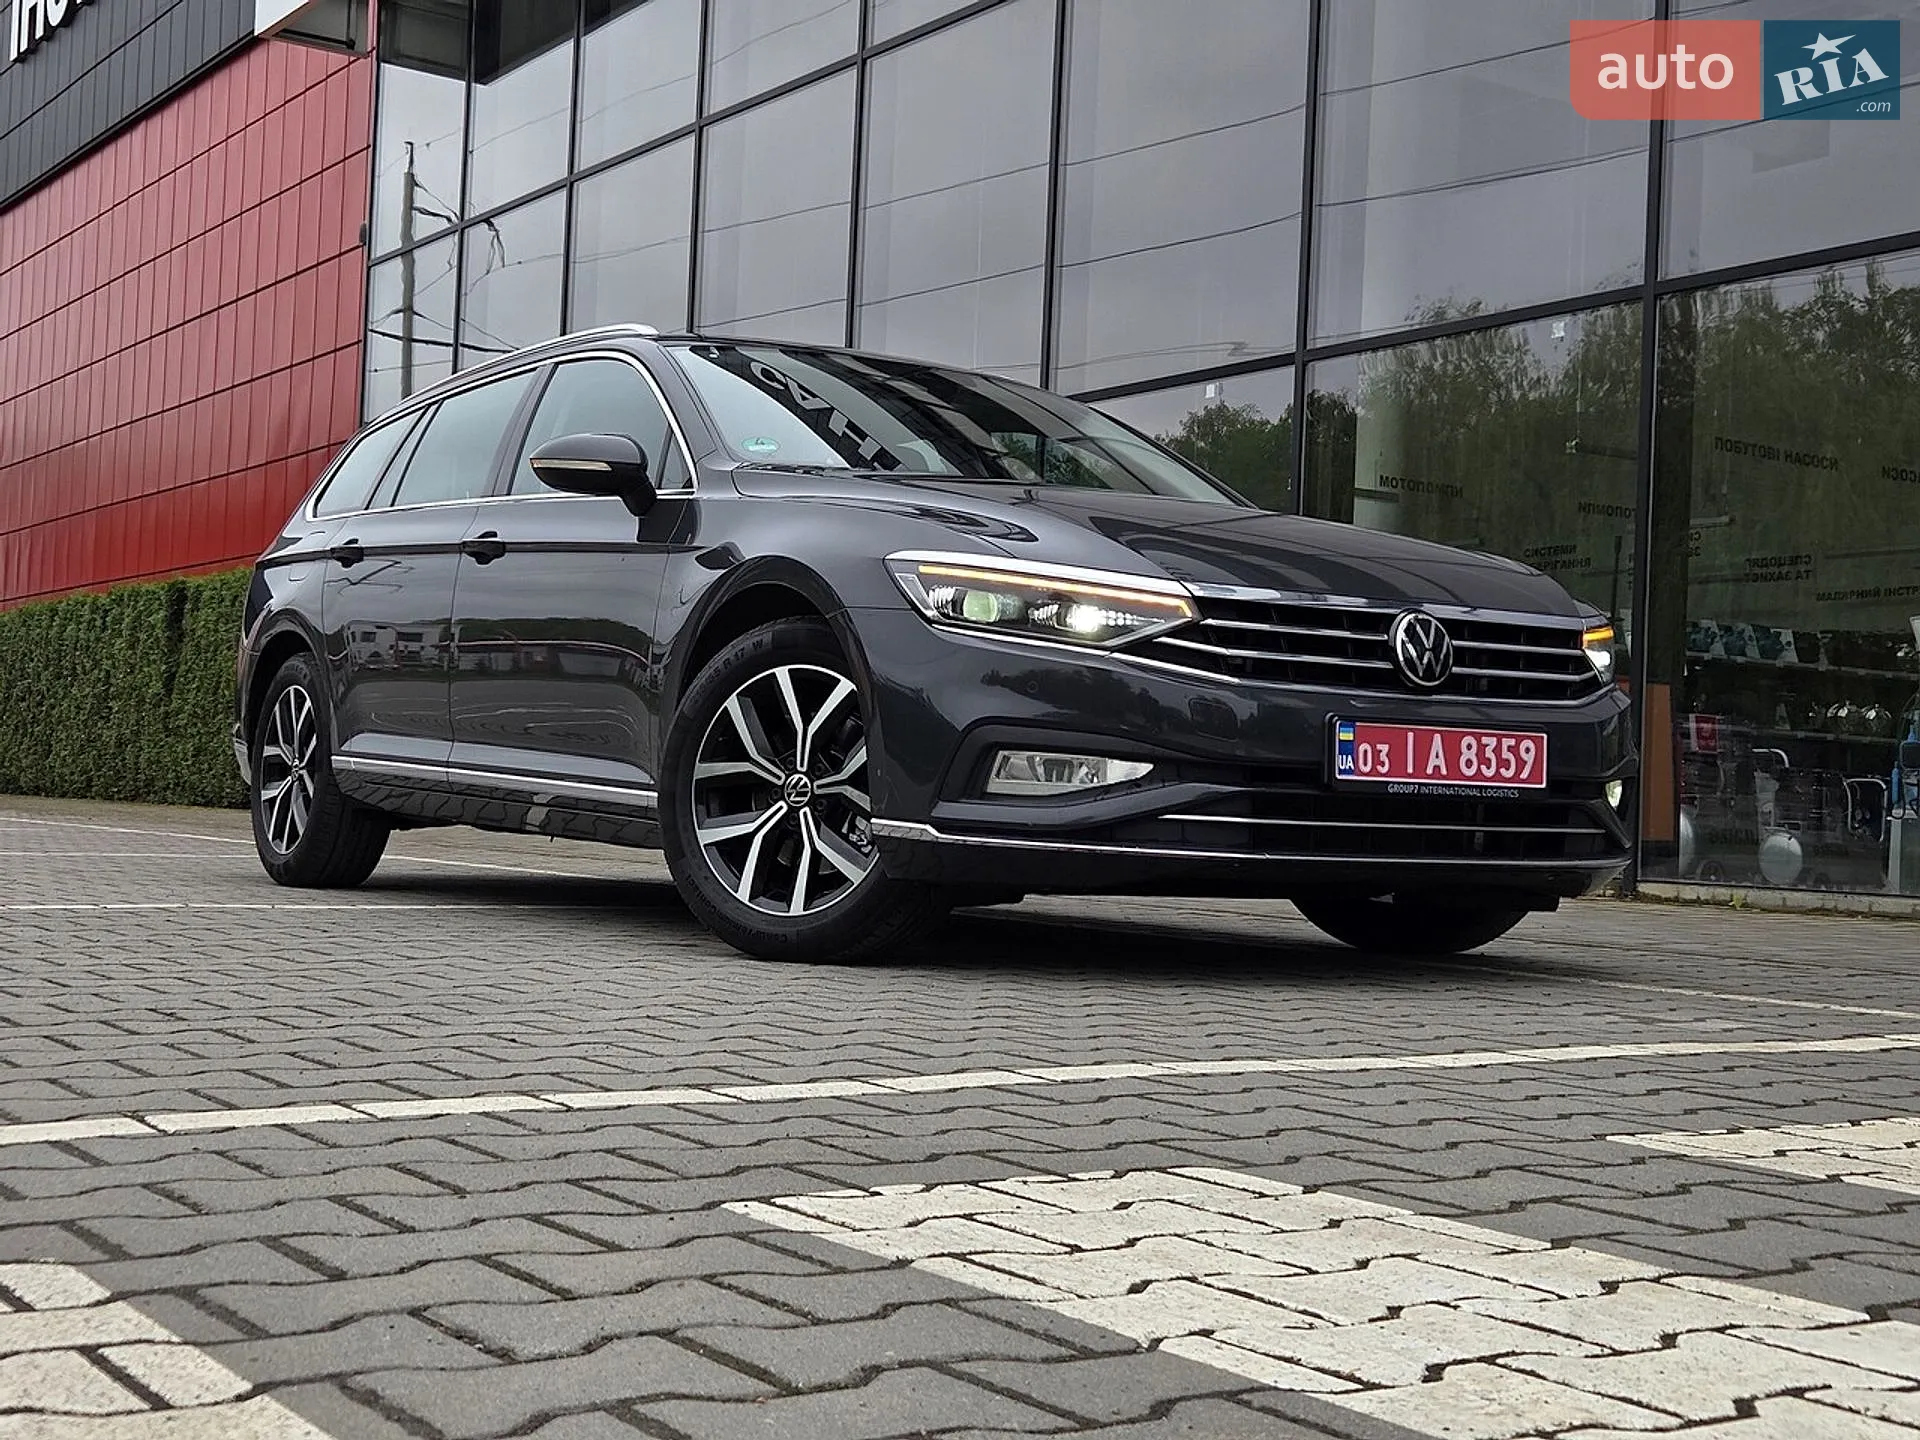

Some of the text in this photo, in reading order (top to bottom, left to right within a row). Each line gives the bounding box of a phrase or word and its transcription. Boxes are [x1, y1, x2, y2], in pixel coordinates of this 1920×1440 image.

[1714, 436, 1839, 471] ПОБУТОВІ НАСОСИ
[1338, 754, 1355, 770] UA
[1358, 731, 1536, 780] 03 IA 8359
[1387, 783, 1520, 798] GROUP7 INTERNATIONAL LOGISTICS
